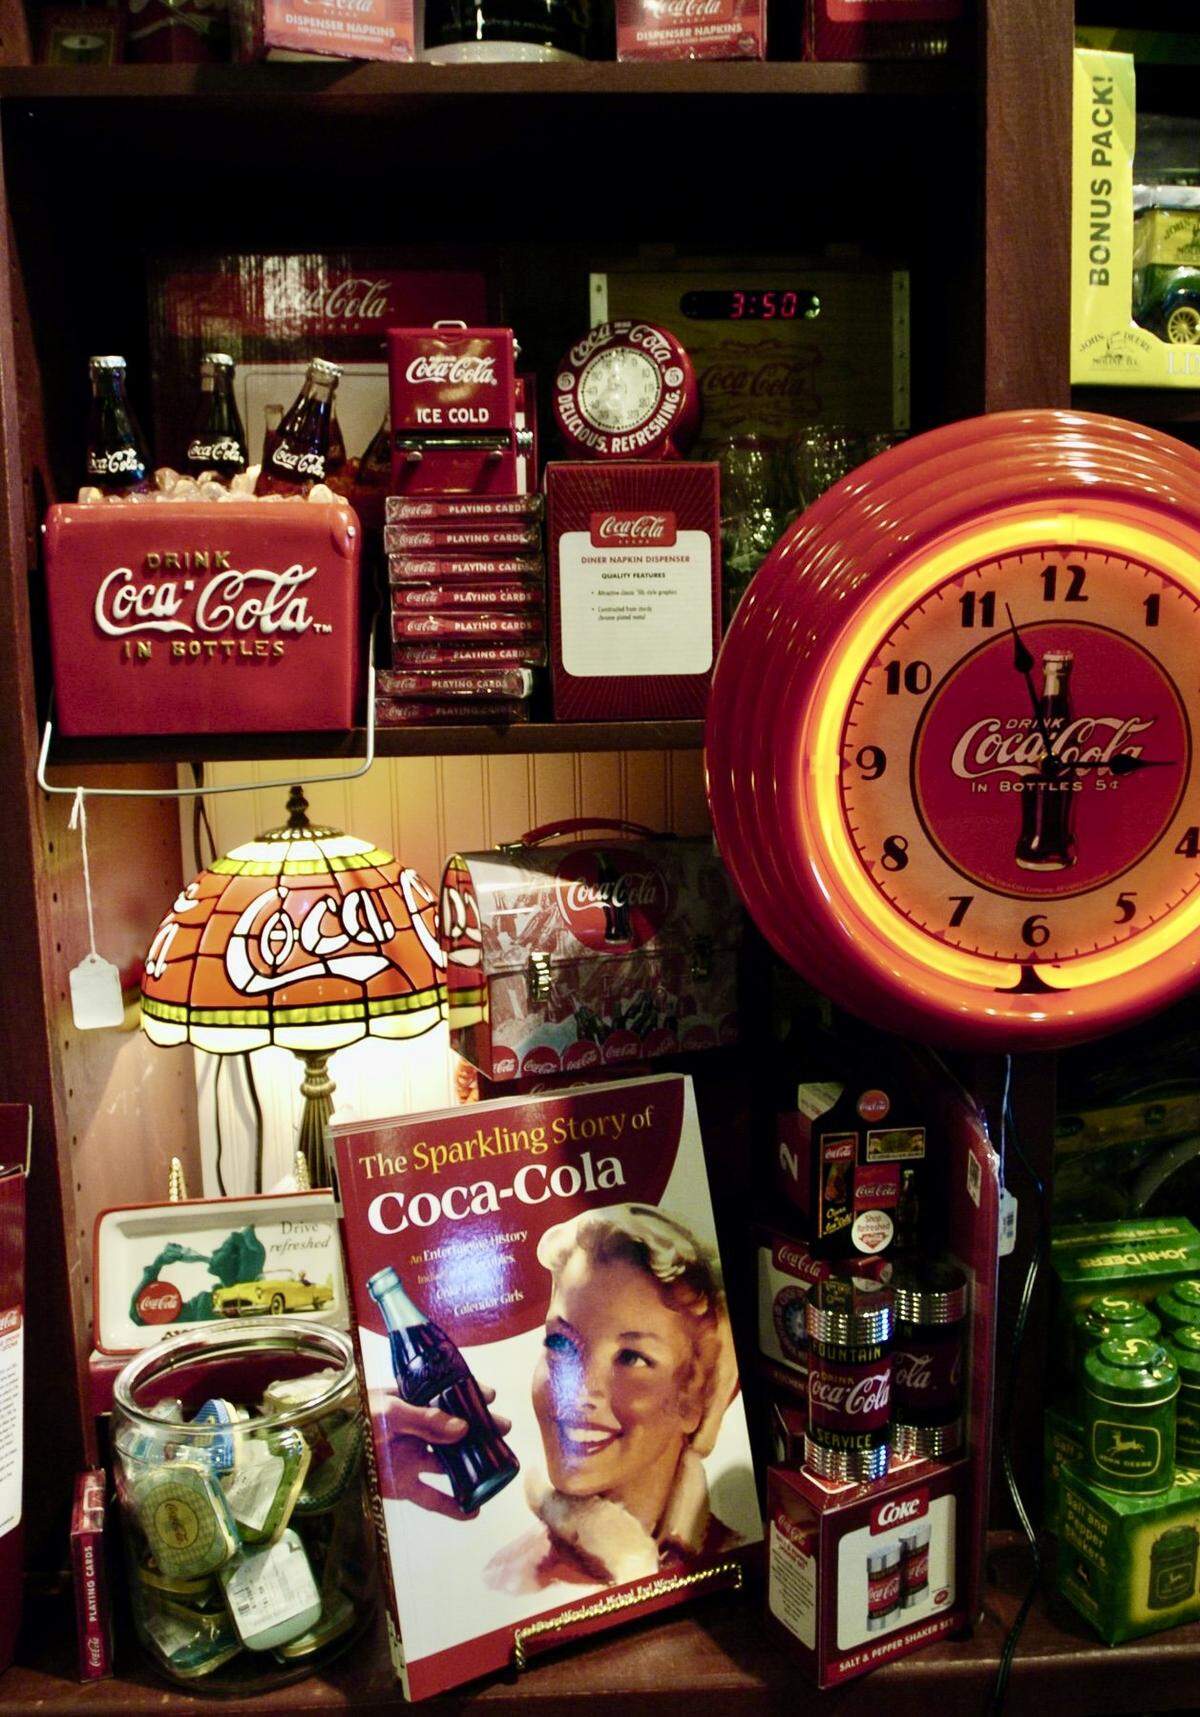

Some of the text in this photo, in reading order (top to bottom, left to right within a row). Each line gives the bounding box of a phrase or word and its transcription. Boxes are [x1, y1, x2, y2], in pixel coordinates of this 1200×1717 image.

[285, 13, 344, 31] DISPENSER
[1089, 75, 1114, 287] BONUS PACK!
[729, 292, 799, 319] 3:50
[416, 407, 490, 423] ICE COLD
[449, 504, 492, 513] PLAYING
[495, 504, 527, 513] CARDS
[446, 535, 490, 543] PLAYING
[146, 550, 232, 569] DRINK
[452, 563, 495, 572] PLAYING
[581, 555, 690, 565] DINER NAPKIN DISPENSER
[601, 571, 666, 580] QUALITY FEATURES
[1040, 564, 1090, 602] 12
[94, 564, 318, 636] Coca-Cola
[453, 592, 497, 601] PLAYING
[958, 590, 996, 628] 11
[1142, 592, 1161, 627] 1
[454, 622, 497, 631] PLAYING
[500, 621, 533, 631] CARDS
[124, 640, 285, 658] IN BOTTLES
[453, 650, 497, 659] PLAYING
[431, 680, 473, 689] PLAYING
[883, 659, 932, 695] 10
[855, 745, 887, 781] 9
[971, 782, 987, 793] IN
[999, 780, 1083, 792] BOTTLES
[880, 834, 909, 872] 8
[1174, 826, 1200, 859] 4
[948, 895, 974, 927] 7
[1113, 891, 1138, 925] 5
[1021, 914, 1051, 948] 6
[359, 1104, 656, 1180] The Sparkling Story of
[367, 1151, 626, 1235] Coca-Cola
[280, 1220, 319, 1236] Drive
[490, 1230, 528, 1248] History
[270, 1234, 332, 1256] refreshed
[1139, 1248, 1190, 1264] JOHN
[816, 1430, 872, 1450] SERVICE
[877, 1497, 920, 1527] Coke
[84, 1546, 96, 1577] CARDS
[84, 1579, 98, 1623] PLAYING
[838, 1656, 860, 1673] SALT
[871, 1637, 904, 1659] PEPPER
[904, 1624, 938, 1646] SHAKER
